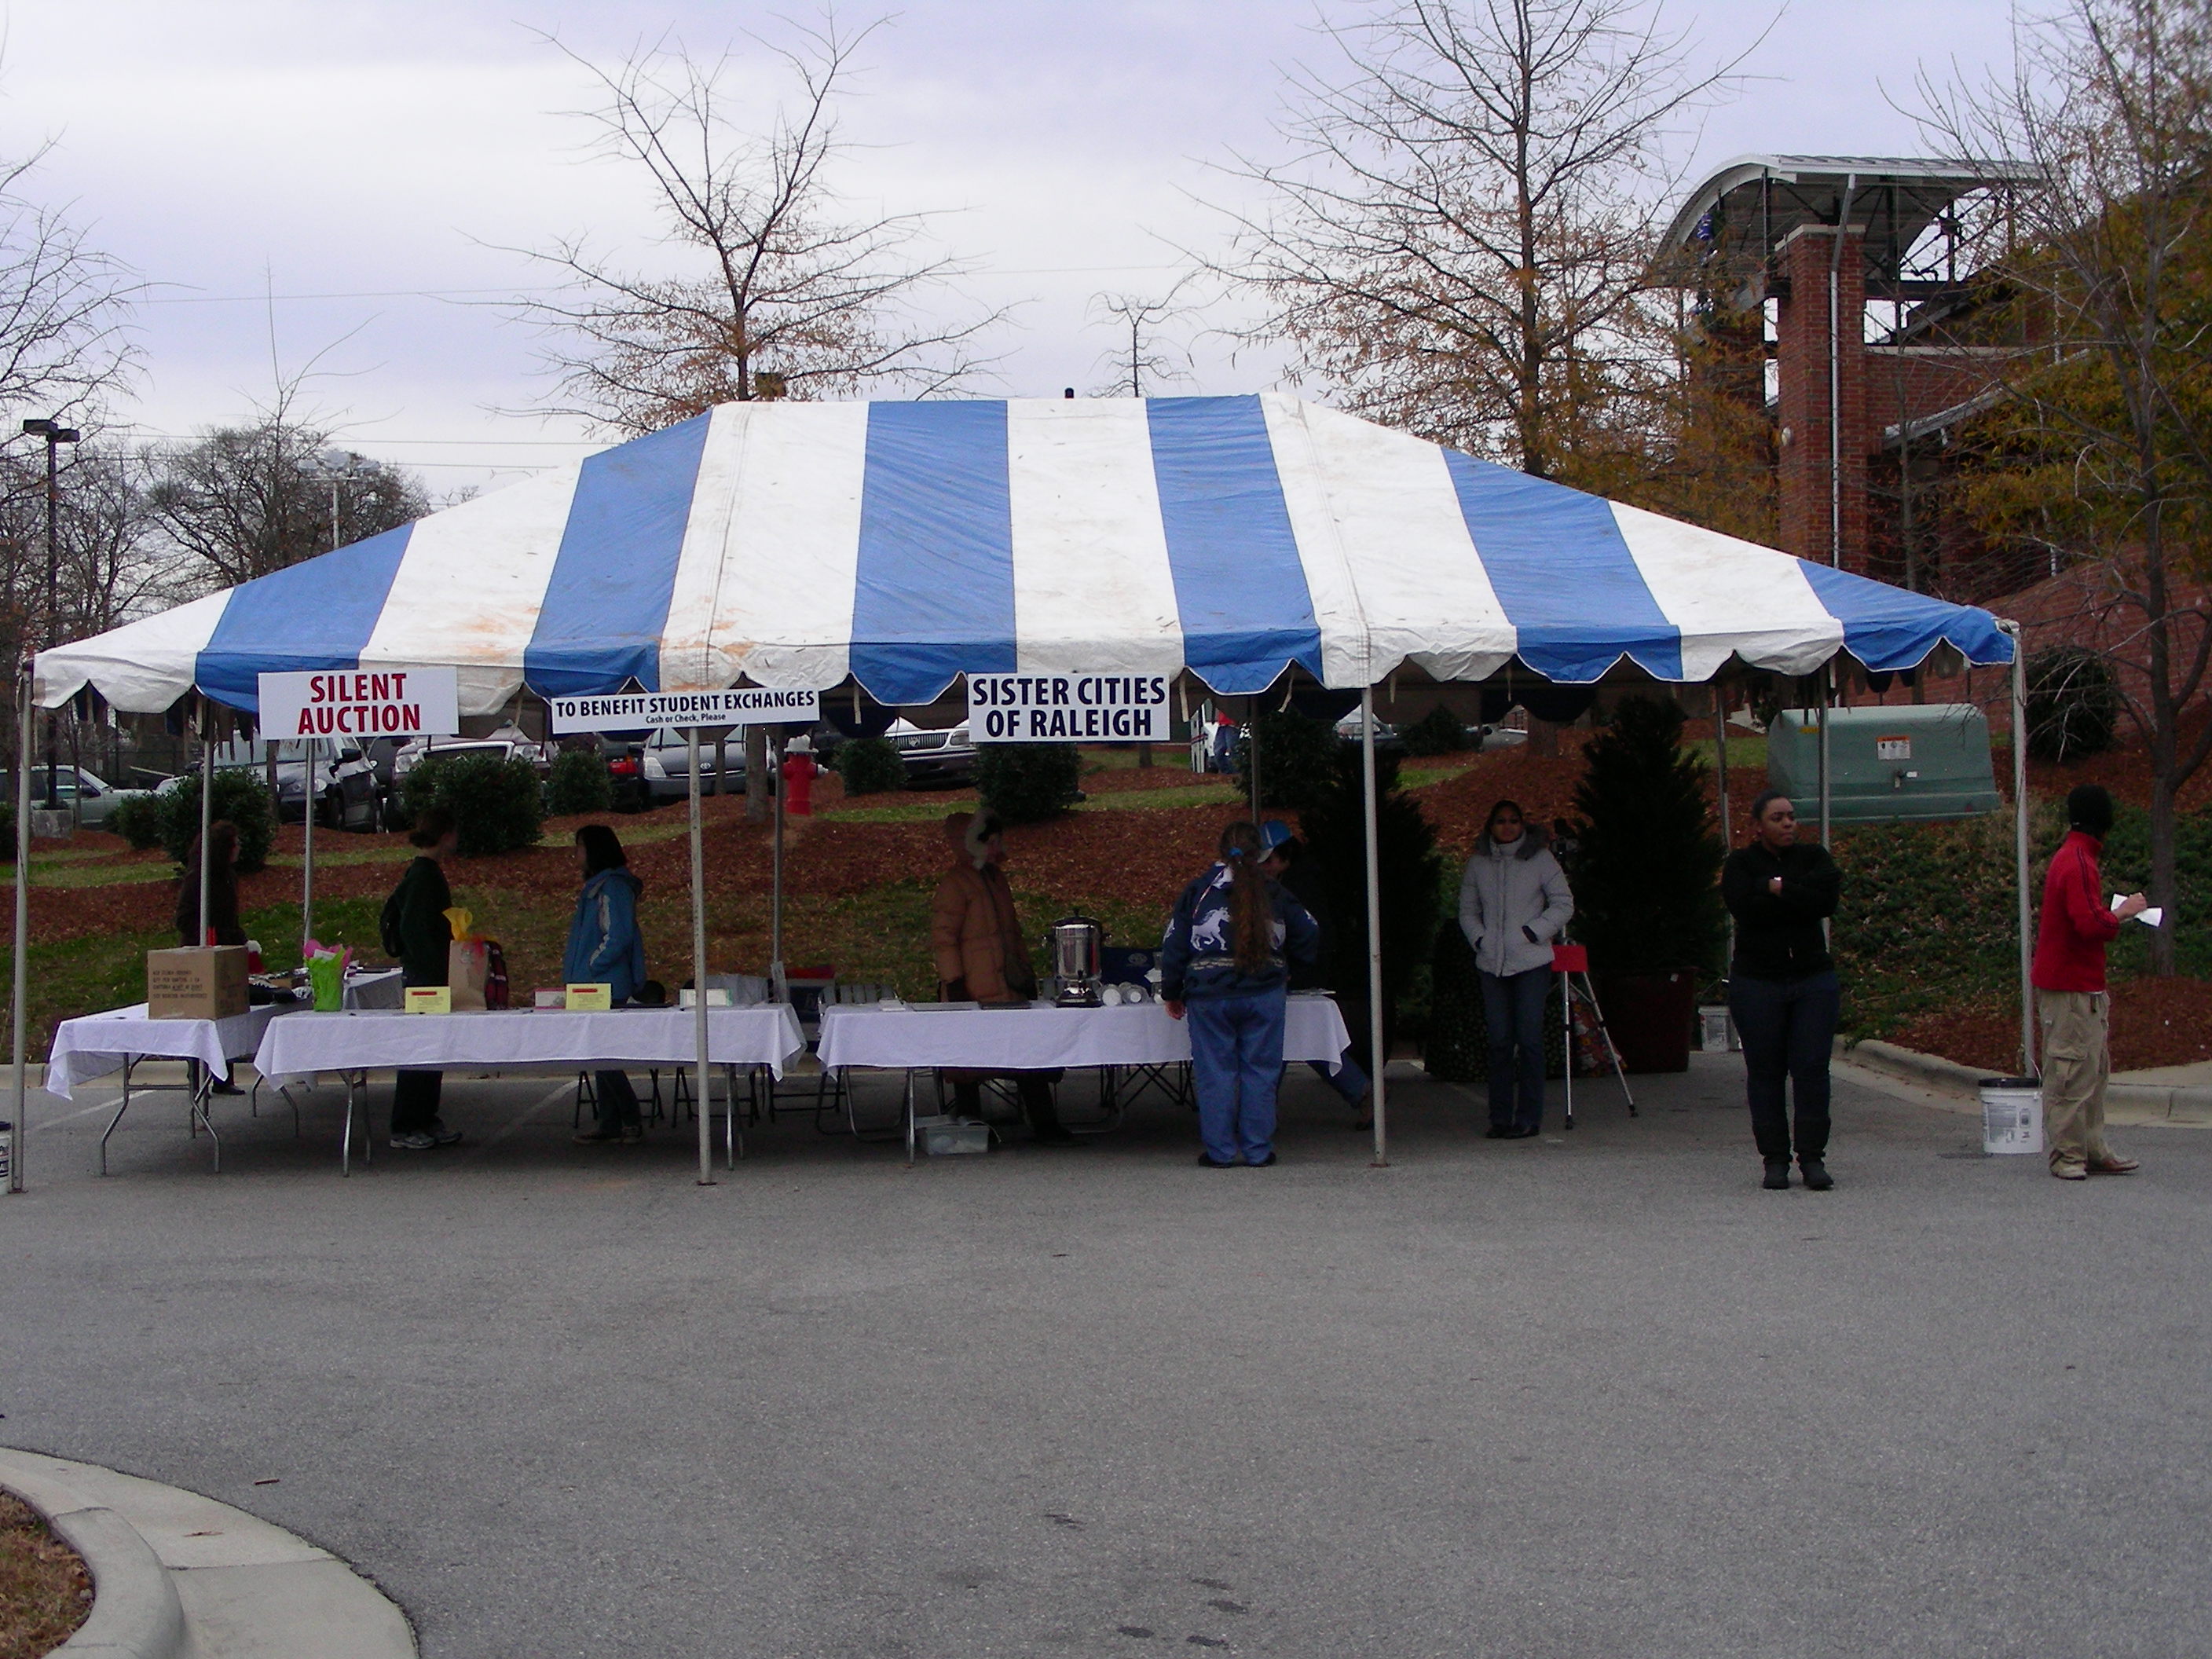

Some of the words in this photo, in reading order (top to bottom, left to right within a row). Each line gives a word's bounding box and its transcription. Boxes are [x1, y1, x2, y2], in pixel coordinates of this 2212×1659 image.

[310, 673, 407, 703] SILENT
[972, 678, 1069, 705] SISTER
[1078, 677, 1165, 705] CITIES
[556, 701, 576, 717] TO
[580, 698, 645, 716] BENEFIT
[650, 695, 720, 713] STUDENT
[724, 690, 815, 710] EXCHANGES
[646, 715, 663, 723] Cash
[701, 712, 726, 721] Please
[298, 704, 420, 734] AUCTION
[986, 709, 1020, 738] OF
[1031, 709, 1151, 737] RALEIGH
